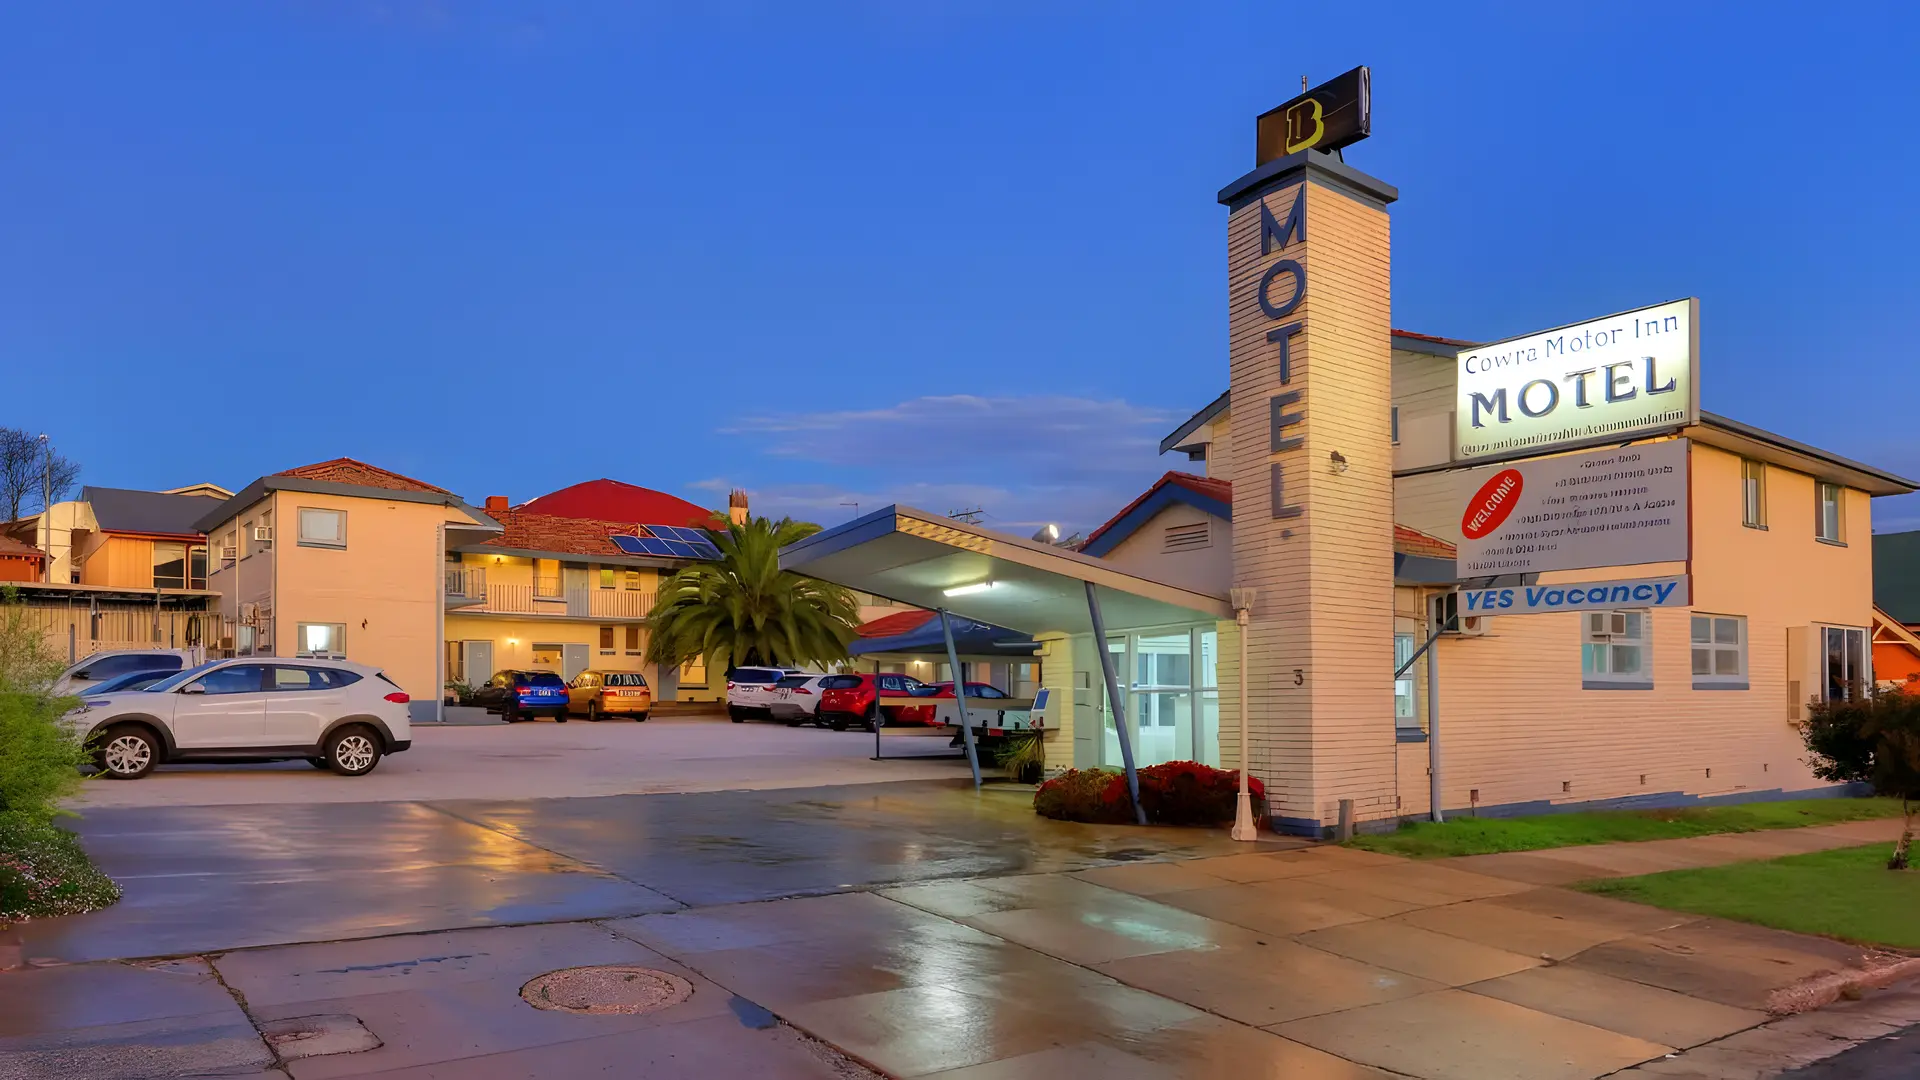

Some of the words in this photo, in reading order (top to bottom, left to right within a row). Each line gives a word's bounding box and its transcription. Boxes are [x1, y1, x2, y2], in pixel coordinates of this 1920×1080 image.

[1258, 183, 1307, 519] MOTEL
[1465, 348, 1537, 374] Cowra
[1546, 329, 1623, 358] Motor
[1635, 315, 1678, 339] Inn
[1467, 356, 1677, 429] MOTEL
[1467, 476, 1516, 532] WELCOME
[1465, 589, 1515, 611] YES
[1525, 581, 1678, 608] Vacancy
[1292, 668, 1304, 686] 3
